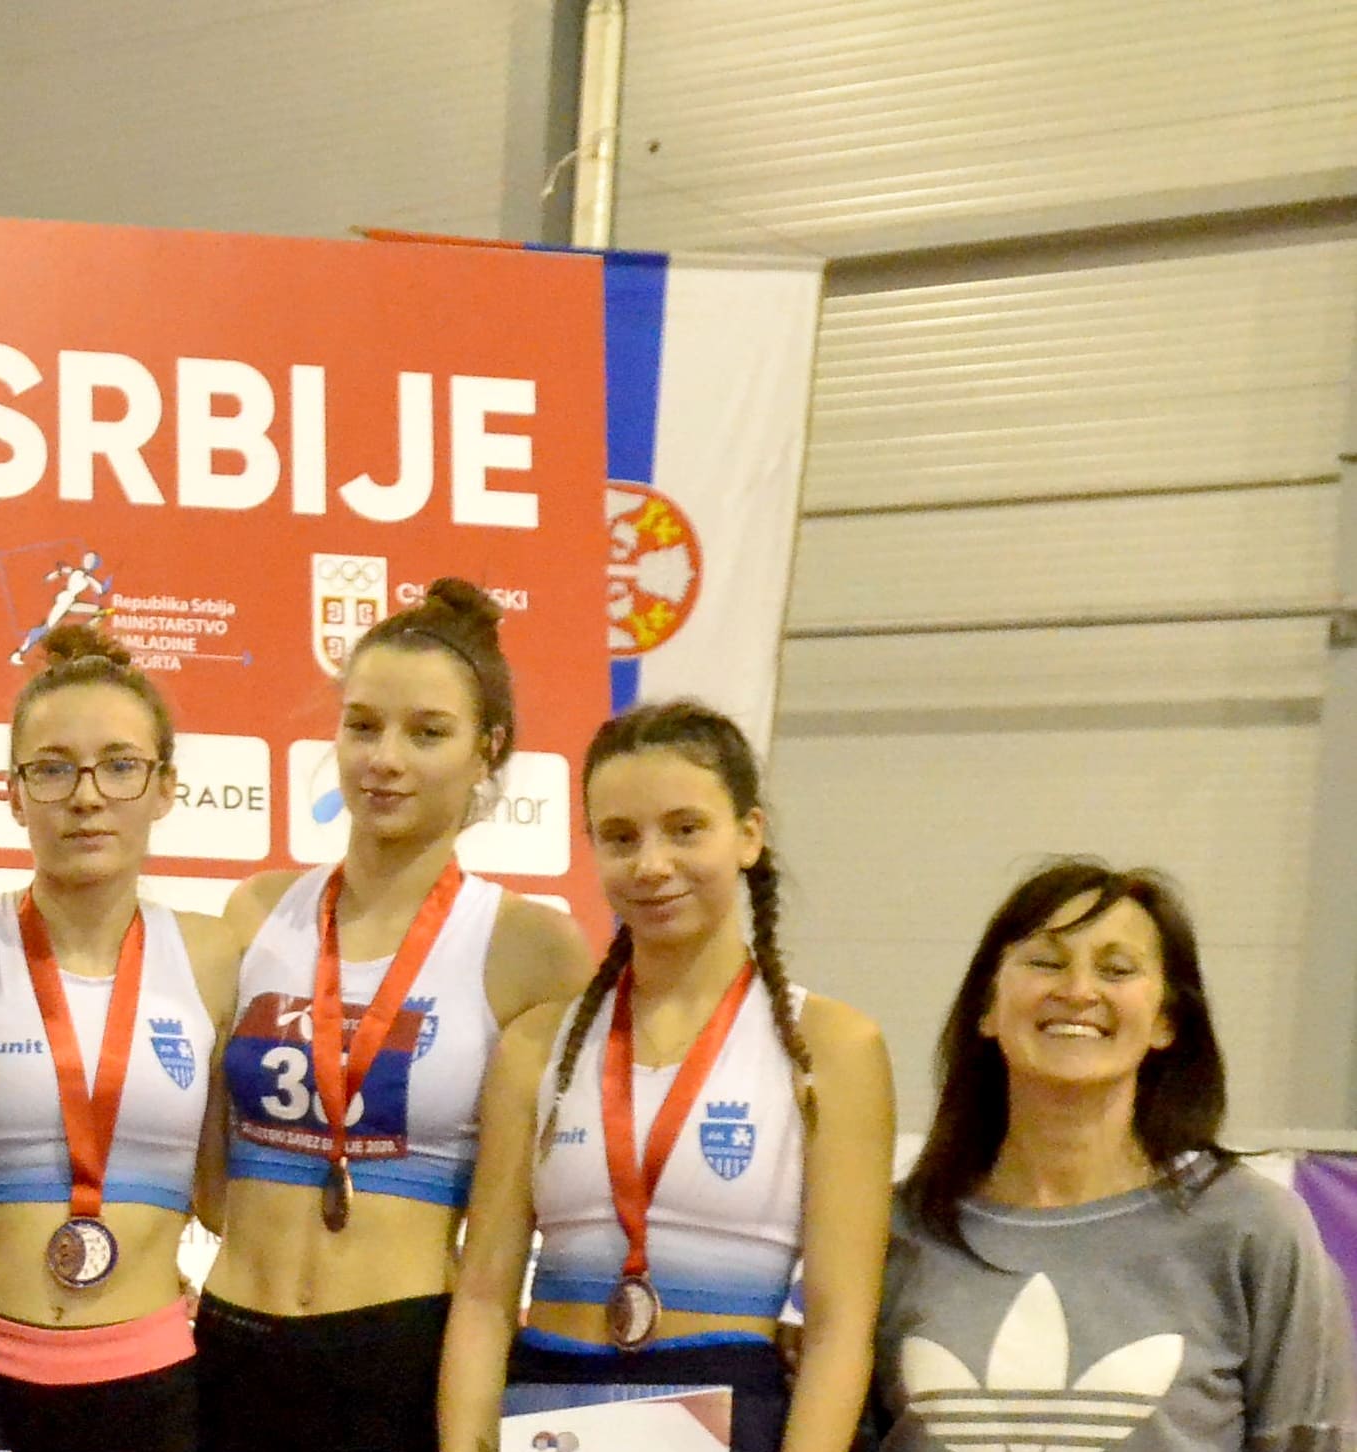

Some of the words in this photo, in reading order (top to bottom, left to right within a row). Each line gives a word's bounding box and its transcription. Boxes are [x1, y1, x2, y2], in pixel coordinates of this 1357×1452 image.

[112, 593, 189, 613] Republika
[190, 598, 236, 617] Srbija
[112, 615, 228, 635] MINISTARSTVO
[113, 634, 198, 652] MLADINE
[554, 1127, 587, 1144] nit
